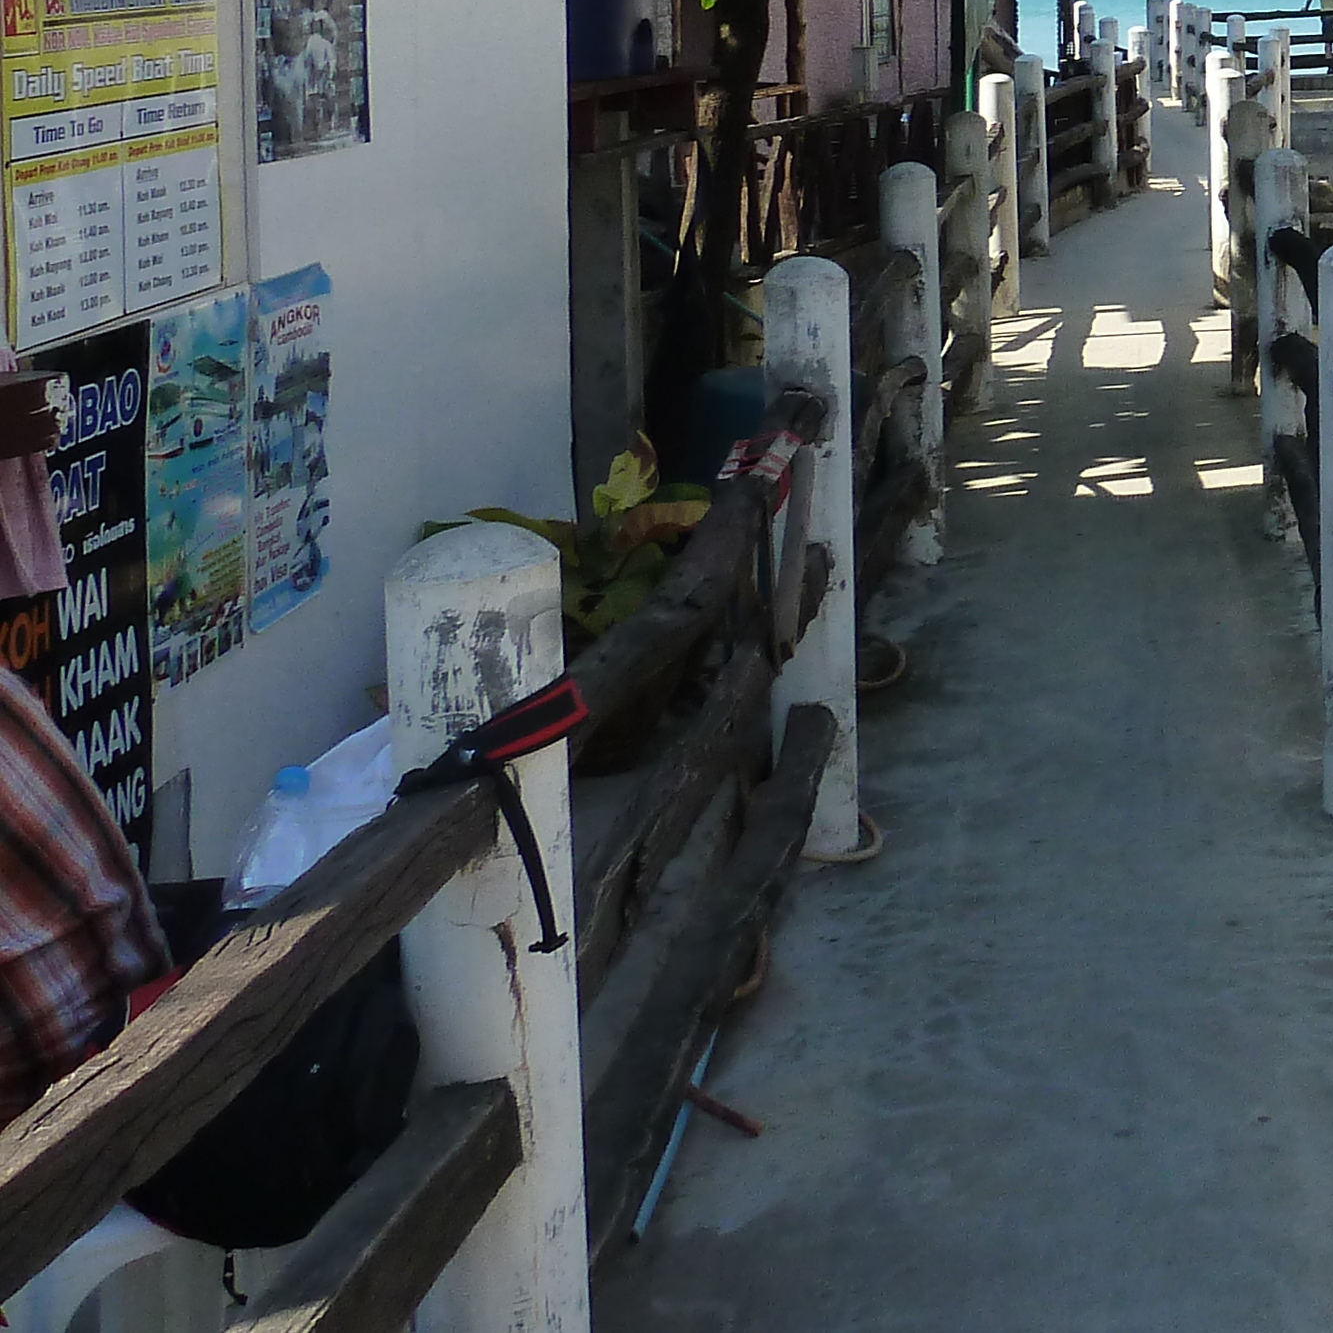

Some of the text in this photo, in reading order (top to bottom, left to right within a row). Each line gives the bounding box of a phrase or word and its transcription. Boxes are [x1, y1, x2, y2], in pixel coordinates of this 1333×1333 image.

[12, 48, 214, 102] Daily Speed Boat Time
[33, 116, 104, 145] Time To Go
[136, 101, 206, 125] Time Return
[28, 189, 54, 206] Arrive
[269, 304, 321, 345] ANGKOR
[50, 450, 107, 525] OAT
[56, 567, 108, 641] WAI
[60, 624, 139, 717] KHAM
